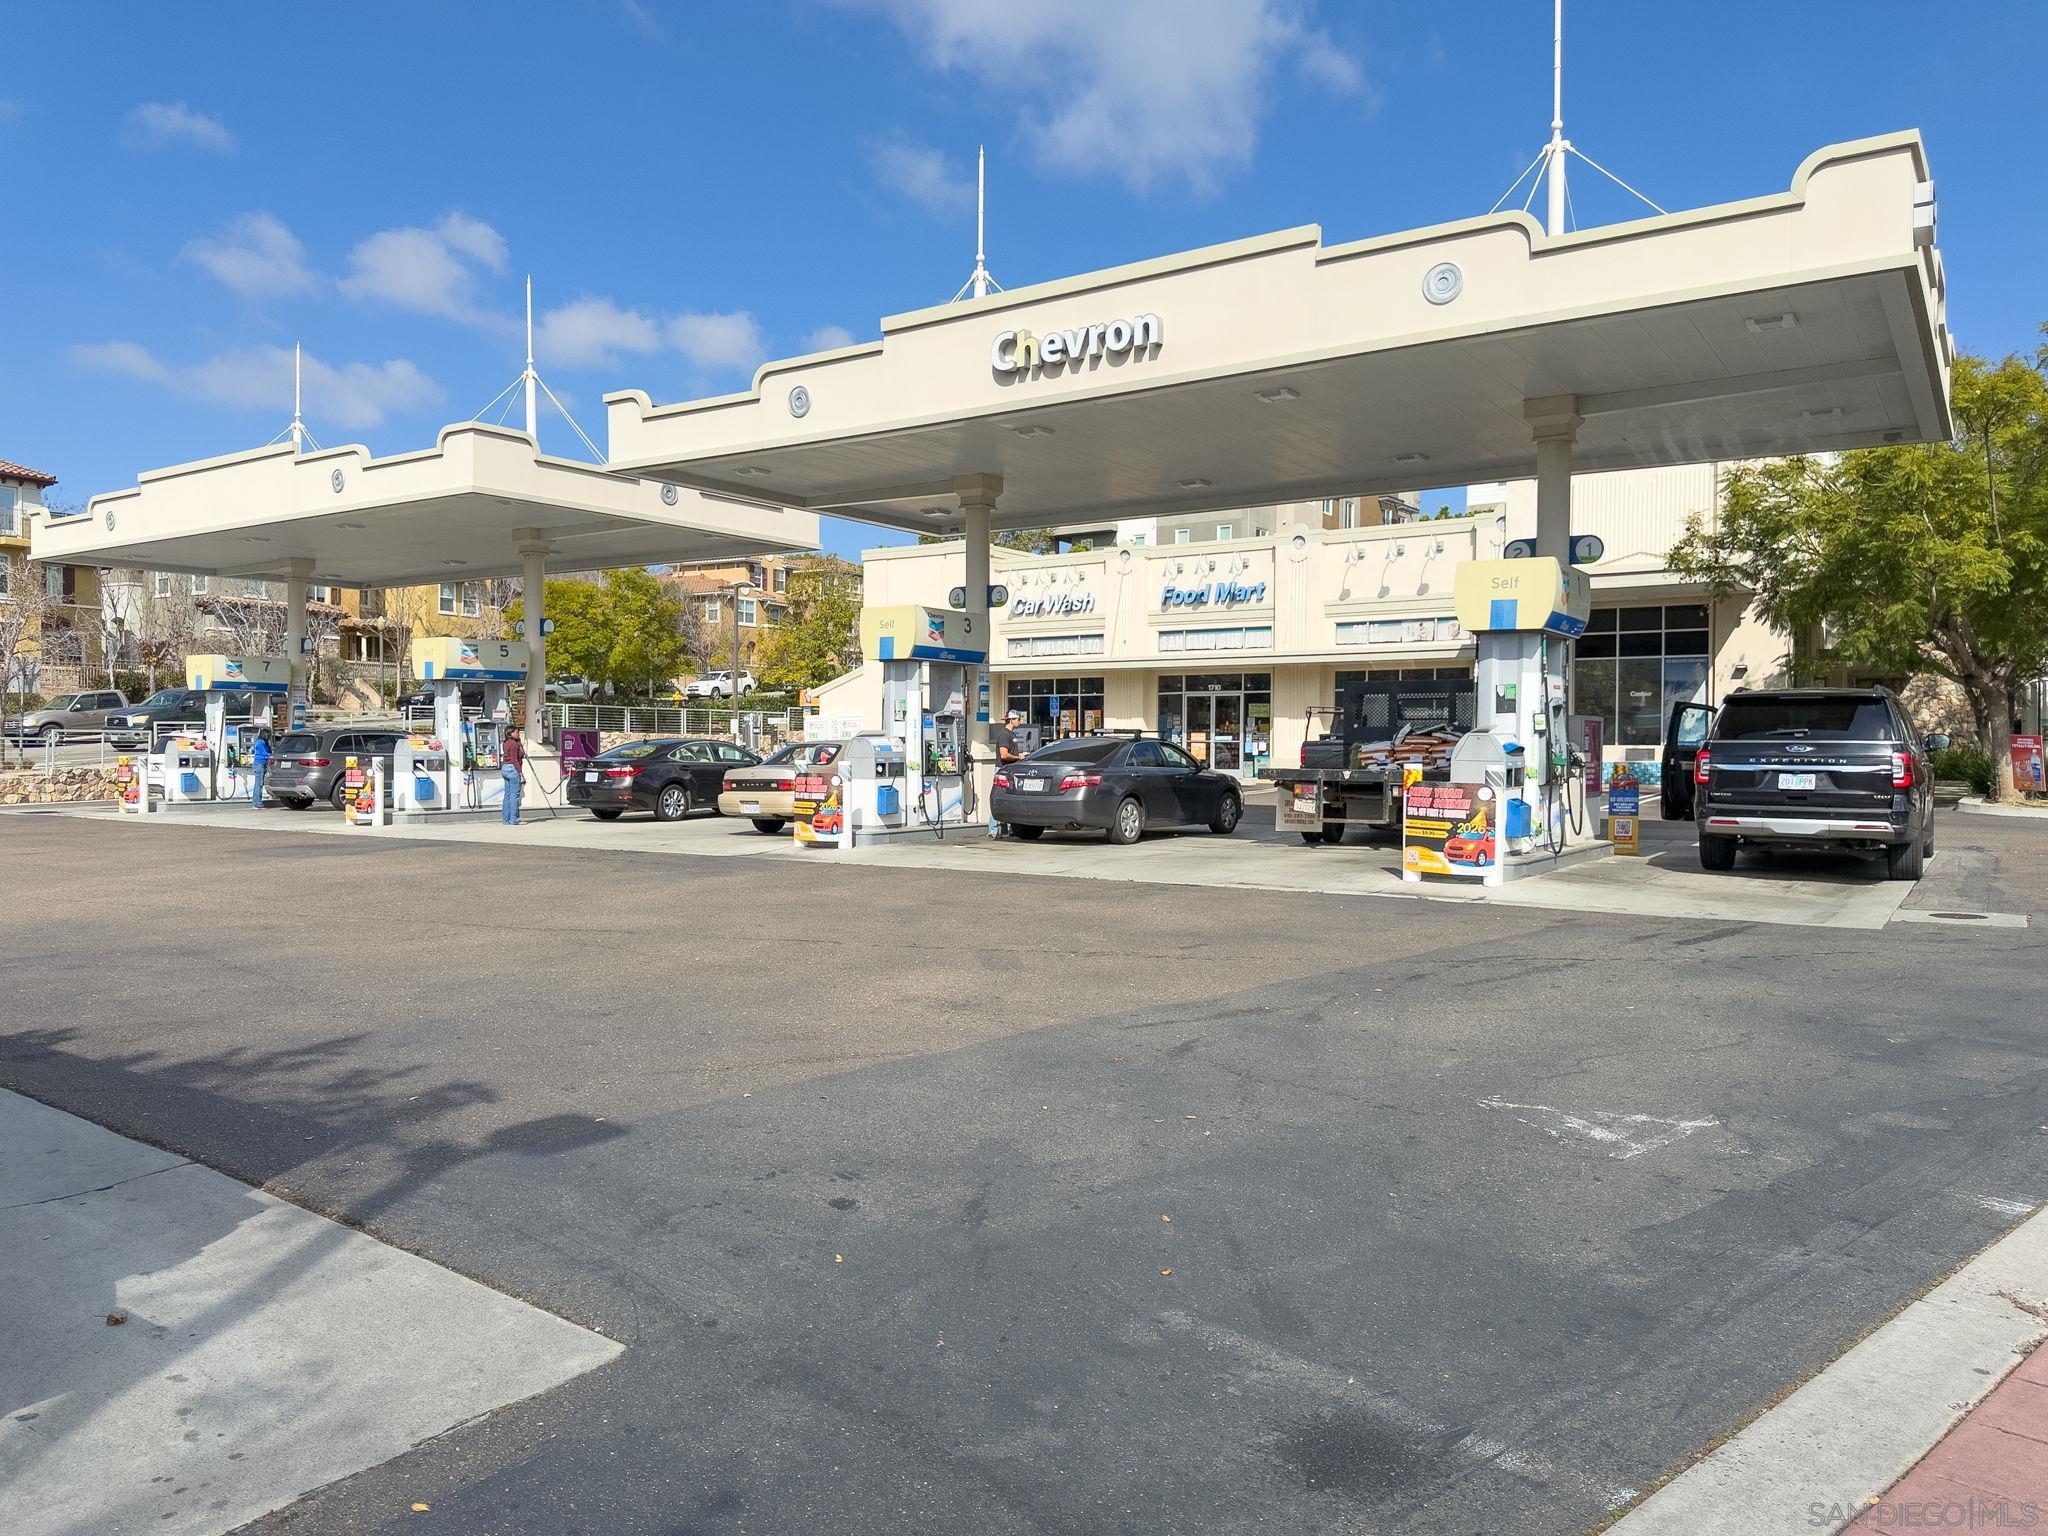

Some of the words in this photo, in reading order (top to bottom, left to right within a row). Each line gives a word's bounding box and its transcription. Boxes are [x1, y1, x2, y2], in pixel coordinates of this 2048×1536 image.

[991, 313, 1163, 372] Chevron
[1586, 543, 1592, 556] 1
[1491, 576, 1520, 589] Self
[954, 592, 961, 603] 4
[996, 591, 1003, 601] 3
[1162, 584, 1209, 606] Food
[1214, 581, 1266, 604] Mart
[1013, 596, 1044, 616] Car
[1044, 593, 1095, 613] Wash
[879, 619, 895, 630] Self
[963, 617, 972, 634] 3
[500, 645, 509, 658] 5
[262, 661, 271, 672] 7
[1434, 787, 1464, 799] YEAR
[1457, 822, 1486, 834] 2026
